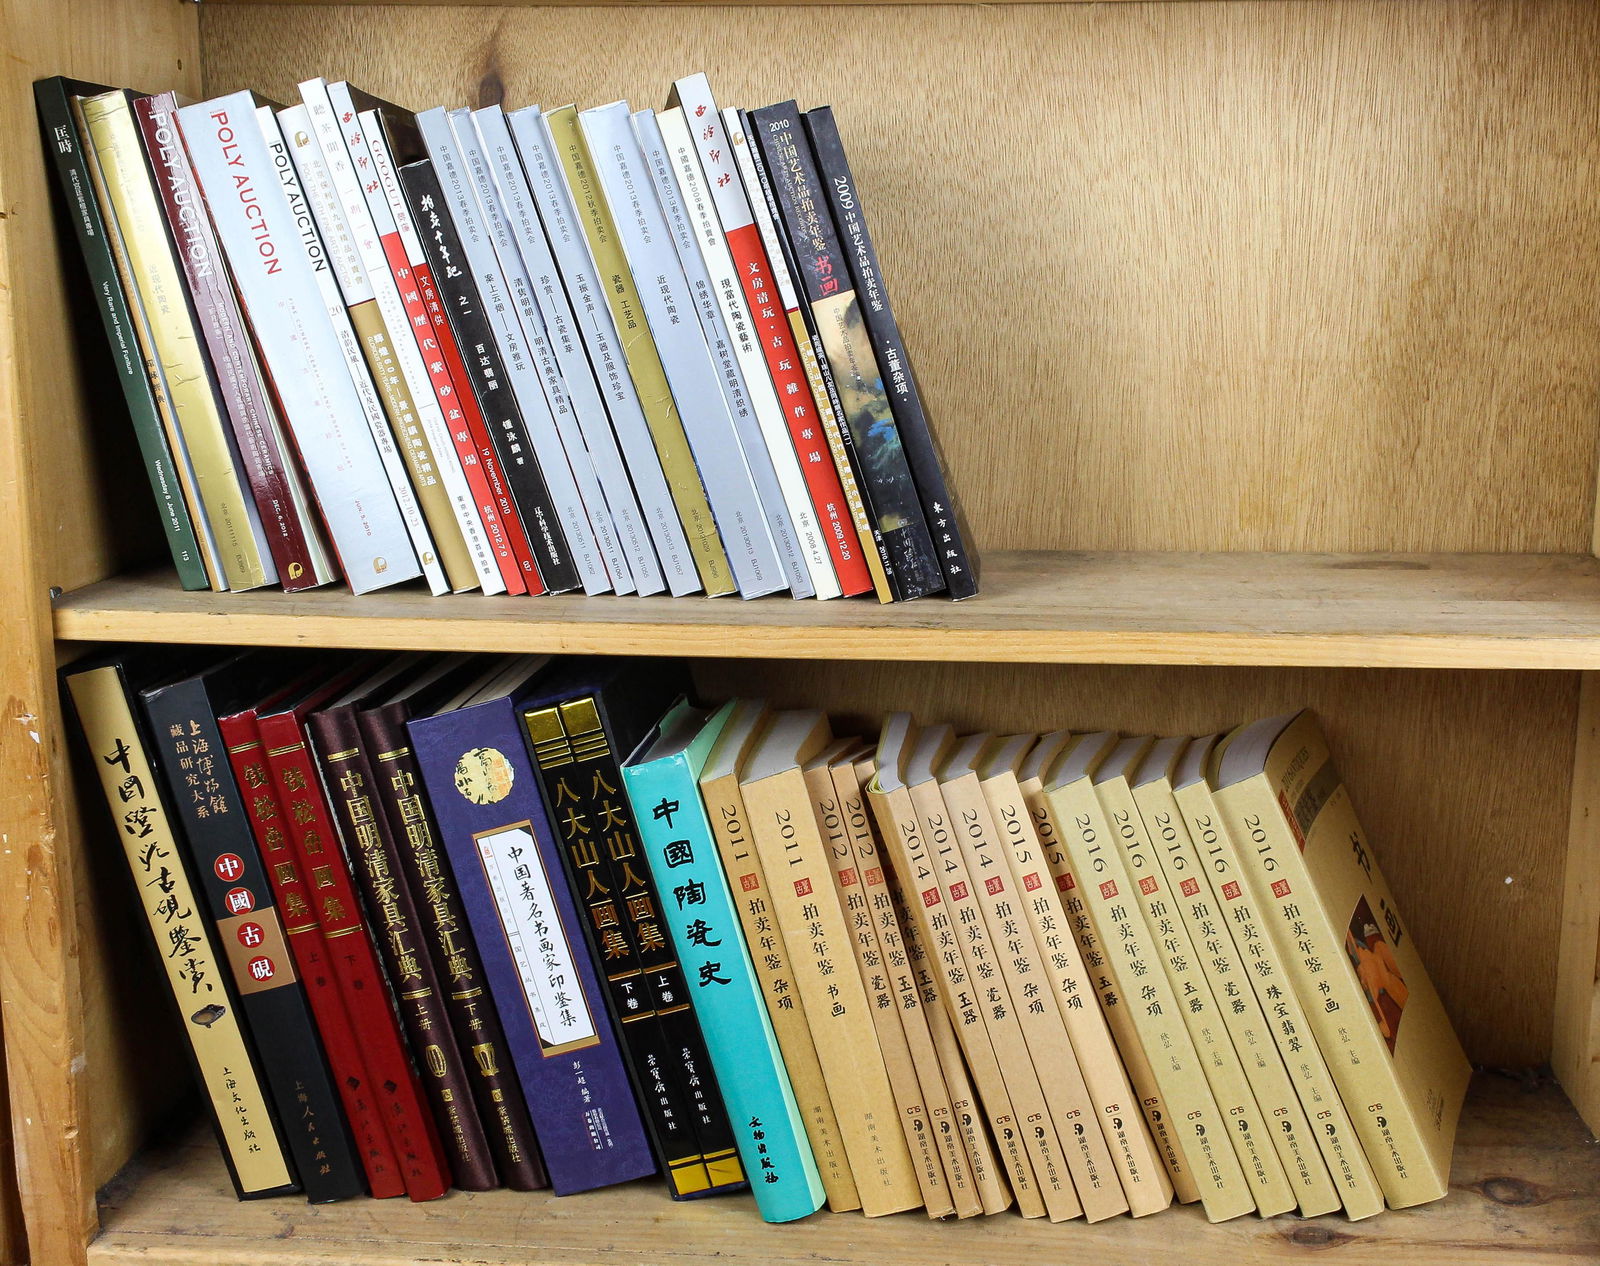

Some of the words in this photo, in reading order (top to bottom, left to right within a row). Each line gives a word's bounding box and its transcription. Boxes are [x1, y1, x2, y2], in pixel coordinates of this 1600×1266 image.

[148, 109, 181, 171] POLY
[169, 173, 213, 278] AUCTION
[209, 109, 245, 168] POLY
[233, 174, 283, 276] AUCTION
[269, 142, 296, 188] POLY
[288, 193, 327, 272] AUCTION
[369, 138, 402, 210] GOOGUT
[769, 118, 790, 133] 2010
[780, 131, 827, 252] 中国艺术品拍卖年鉴
[815, 255, 840, 297] 书画
[834, 175, 855, 210] 2009
[100, 280, 111, 296] Very
[844, 212, 884, 312] 中国艺术品拍卖年鉴
[105, 296, 116, 311] Rare
[110, 311, 120, 324] and
[112, 324, 128, 349] Imperial
[420, 275, 444, 326] 文房清供
[612, 275, 625, 294] 瓷器
[620, 300, 637, 329] 工艺品
[656, 275, 680, 326] 近现代陶瓷
[720, 278, 753, 353] 現當代陶瓷藝術
[216, 301, 231, 331] MODERN
[226, 333, 236, 349] AND
[231, 350, 255, 405] CONTEMPORARY
[246, 408, 264, 437] CHINESE
[256, 439, 277, 475] CERAMICS
[151, 459, 171, 495] Wednesday
[481, 446, 490, 456] 19
[483, 457, 505, 495] November
[166, 501, 176, 517] June
[170, 516, 181, 532] 2011
[271, 498, 282, 514] DEC.
[278, 521, 289, 537] 2012
[487, 522, 510, 558] 2012.7.9
[498, 496, 511, 515] 2010
[598, 525, 616, 554] 20130511
[827, 520, 855, 562] 2009.12.20
[180, 549, 189, 561] 113
[520, 558, 534, 573] 037
[169, 723, 210, 819] 藏品研究大系
[341, 770, 422, 983] 中国明清家具汇典
[391, 770, 473, 983] 中国明清家具汇典
[557, 777, 630, 961] 八大山人画集
[592, 769, 665, 953] 八大山人画集
[652, 797, 732, 988] 中國陶瓷史
[507, 846, 577, 1027] 中国著名书画家印鉴集
[720, 804, 750, 862] 2011
[749, 898, 783, 971] 拍卖年鉴
[773, 978, 794, 1010] 杂项
[775, 809, 804, 868] 2011
[802, 903, 835, 976] 拍卖年鉴
[827, 984, 846, 1018] 书画
[819, 799, 848, 860] 2012
[847, 893, 881, 968] 拍卖年鉴
[871, 975, 891, 1010] 瓷器
[845, 798, 874, 859] 2012
[874, 892, 907, 968] 拍卖年鉴
[898, 976, 917, 1010] 玉器
[901, 820, 931, 880] 2014
[931, 912, 965, 985] 拍卖年鉴
[959, 991, 978, 1026] 玉器
[927, 814, 958, 874] 2014
[959, 906, 994, 980] 拍卖年鉴
[986, 987, 1007, 1021] 瓷器
[962, 809, 994, 869] 2014
[995, 901, 1032, 975] 拍卖年鉴
[1023, 983, 1045, 1015] 杂项
[1000, 804, 1033, 864] 2015
[1033, 897, 1070, 970] 拍卖年鉴
[1062, 977, 1083, 1010] 杂项
[1032, 807, 1065, 866] 2015
[1067, 897, 1104, 968] 拍卖年鉴
[1099, 976, 1119, 1008] 玉器
[1075, 813, 1109, 874] 2016
[1111, 904, 1149, 977] 拍卖年鉴
[1140, 985, 1163, 1017] 杂项
[1114, 809, 1148, 870] 2016
[1150, 900, 1188, 973] 拍卖年鉴
[1183, 981, 1205, 1015] 玉器
[1154, 811, 1190, 872] 2016
[1192, 902, 1232, 975] 拍卖年鉴
[1224, 981, 1247, 1015] 瓷器
[1195, 814, 1231, 873] 2016
[1233, 905, 1273, 977] 拍卖年鉴
[1266, 984, 1303, 1053] 珠宝翡翠
[1244, 814, 1280, 872] 2016
[1282, 903, 1324, 975] 拍卖年鉴
[1318, 981, 1341, 1014] 书画
[415, 1005, 432, 1030] 上册
[465, 1004, 483, 1030] 下册
[621, 982, 639, 1010] 下卷
[657, 975, 674, 1003] 上卷
[918, 970, 938, 1004] 玉器
[748, 1116, 780, 1185] 文物出版社
